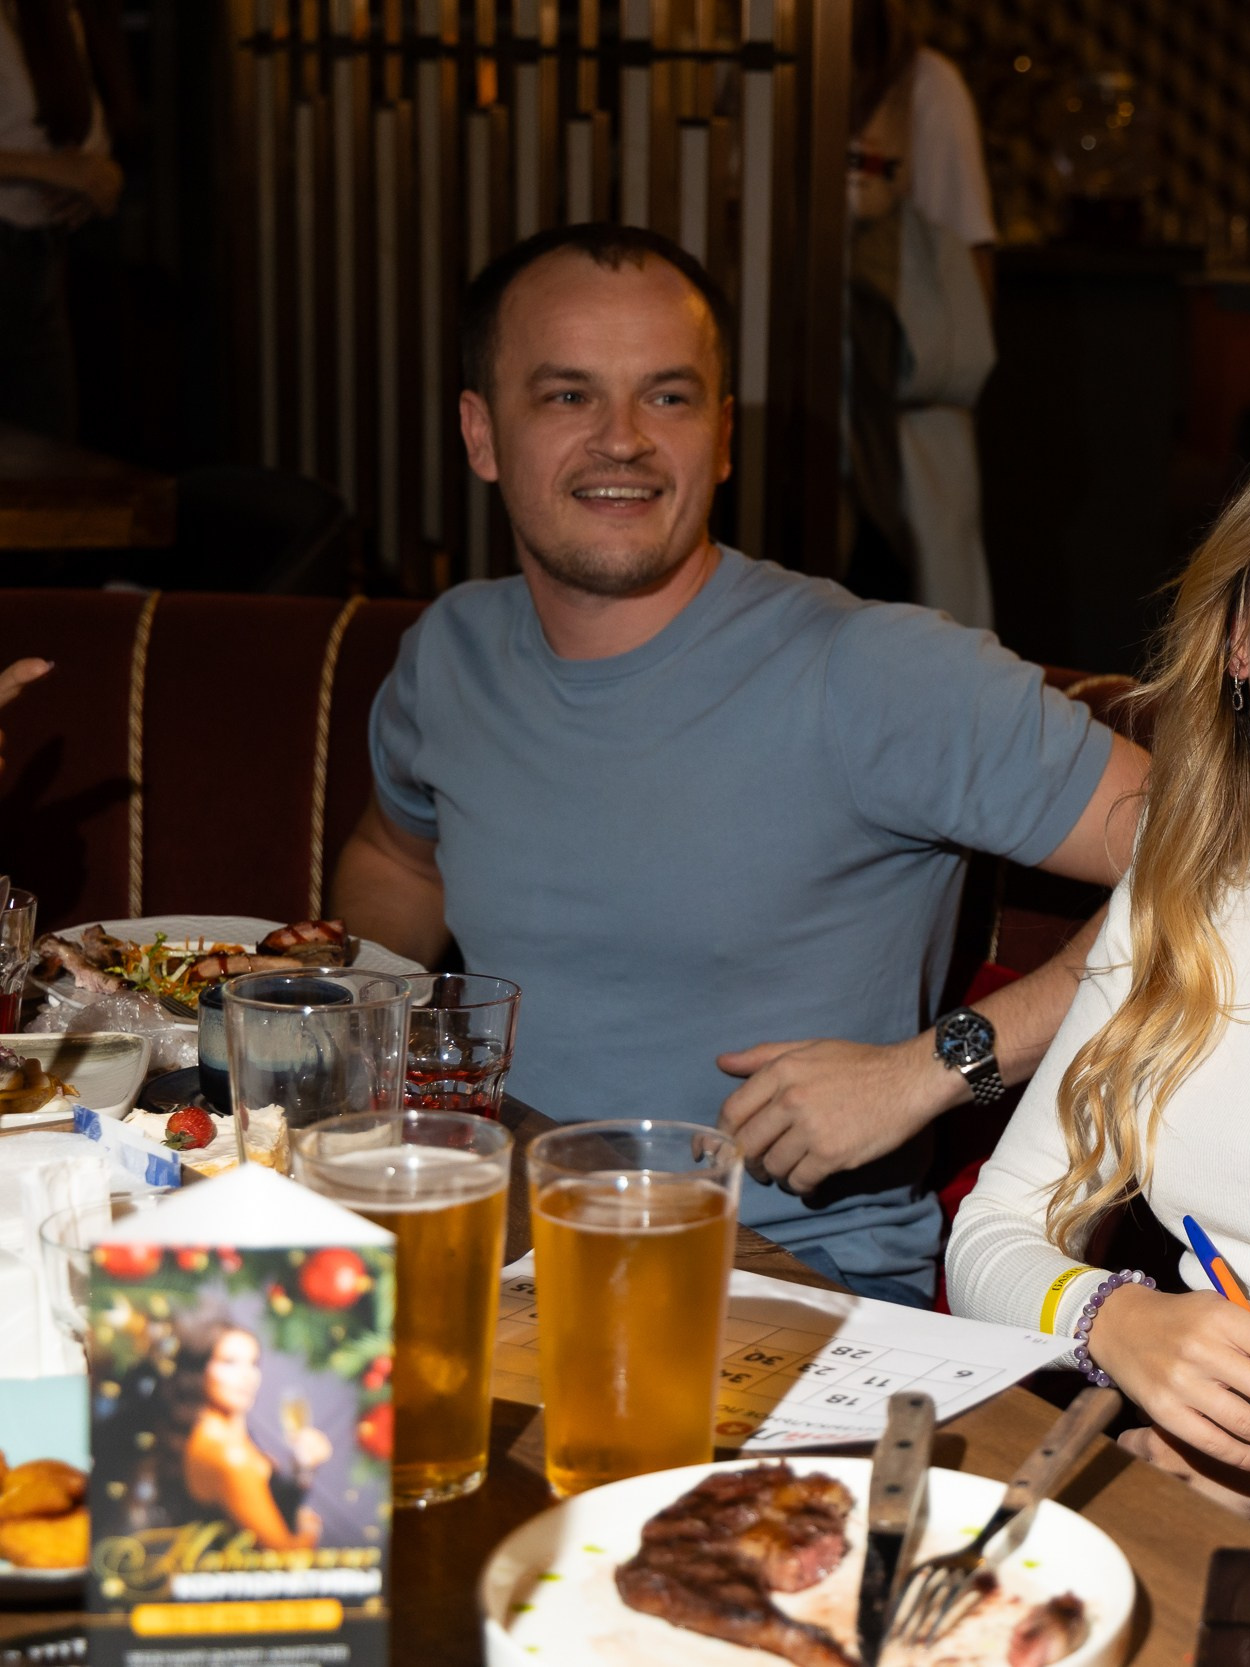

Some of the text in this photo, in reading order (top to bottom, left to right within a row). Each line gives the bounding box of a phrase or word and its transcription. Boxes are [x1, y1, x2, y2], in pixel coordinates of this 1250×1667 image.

[743, 1351, 785, 1366] 30
[830, 1345, 874, 1360] 28
[797, 1361, 837, 1377] 23
[953, 1369, 975, 1379] 6
[862, 1375, 892, 1388] 11
[825, 1393, 862, 1407] 18
